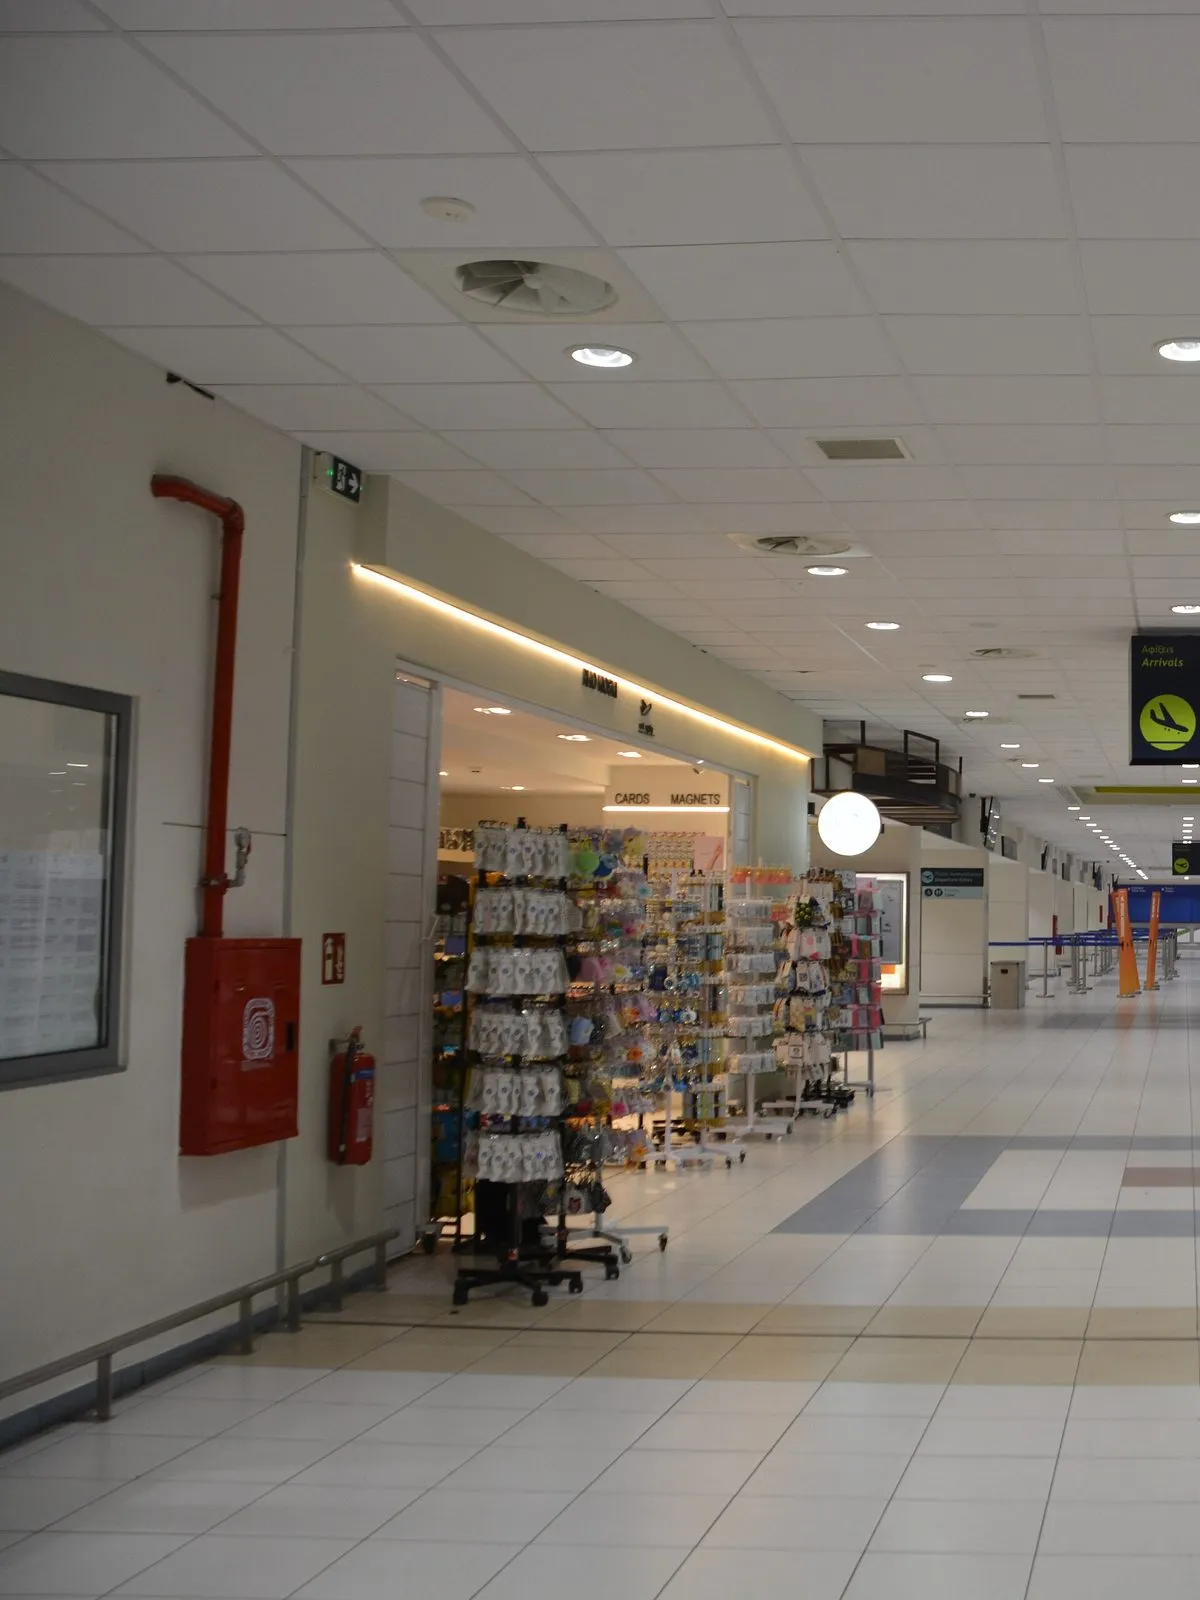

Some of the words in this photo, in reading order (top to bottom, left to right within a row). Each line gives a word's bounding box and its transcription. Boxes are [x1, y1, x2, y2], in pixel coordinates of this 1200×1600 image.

[1141, 656, 1184, 668] Arrivals
[614, 793, 650, 805] CARDS
[670, 793, 721, 805] MAGNETS
